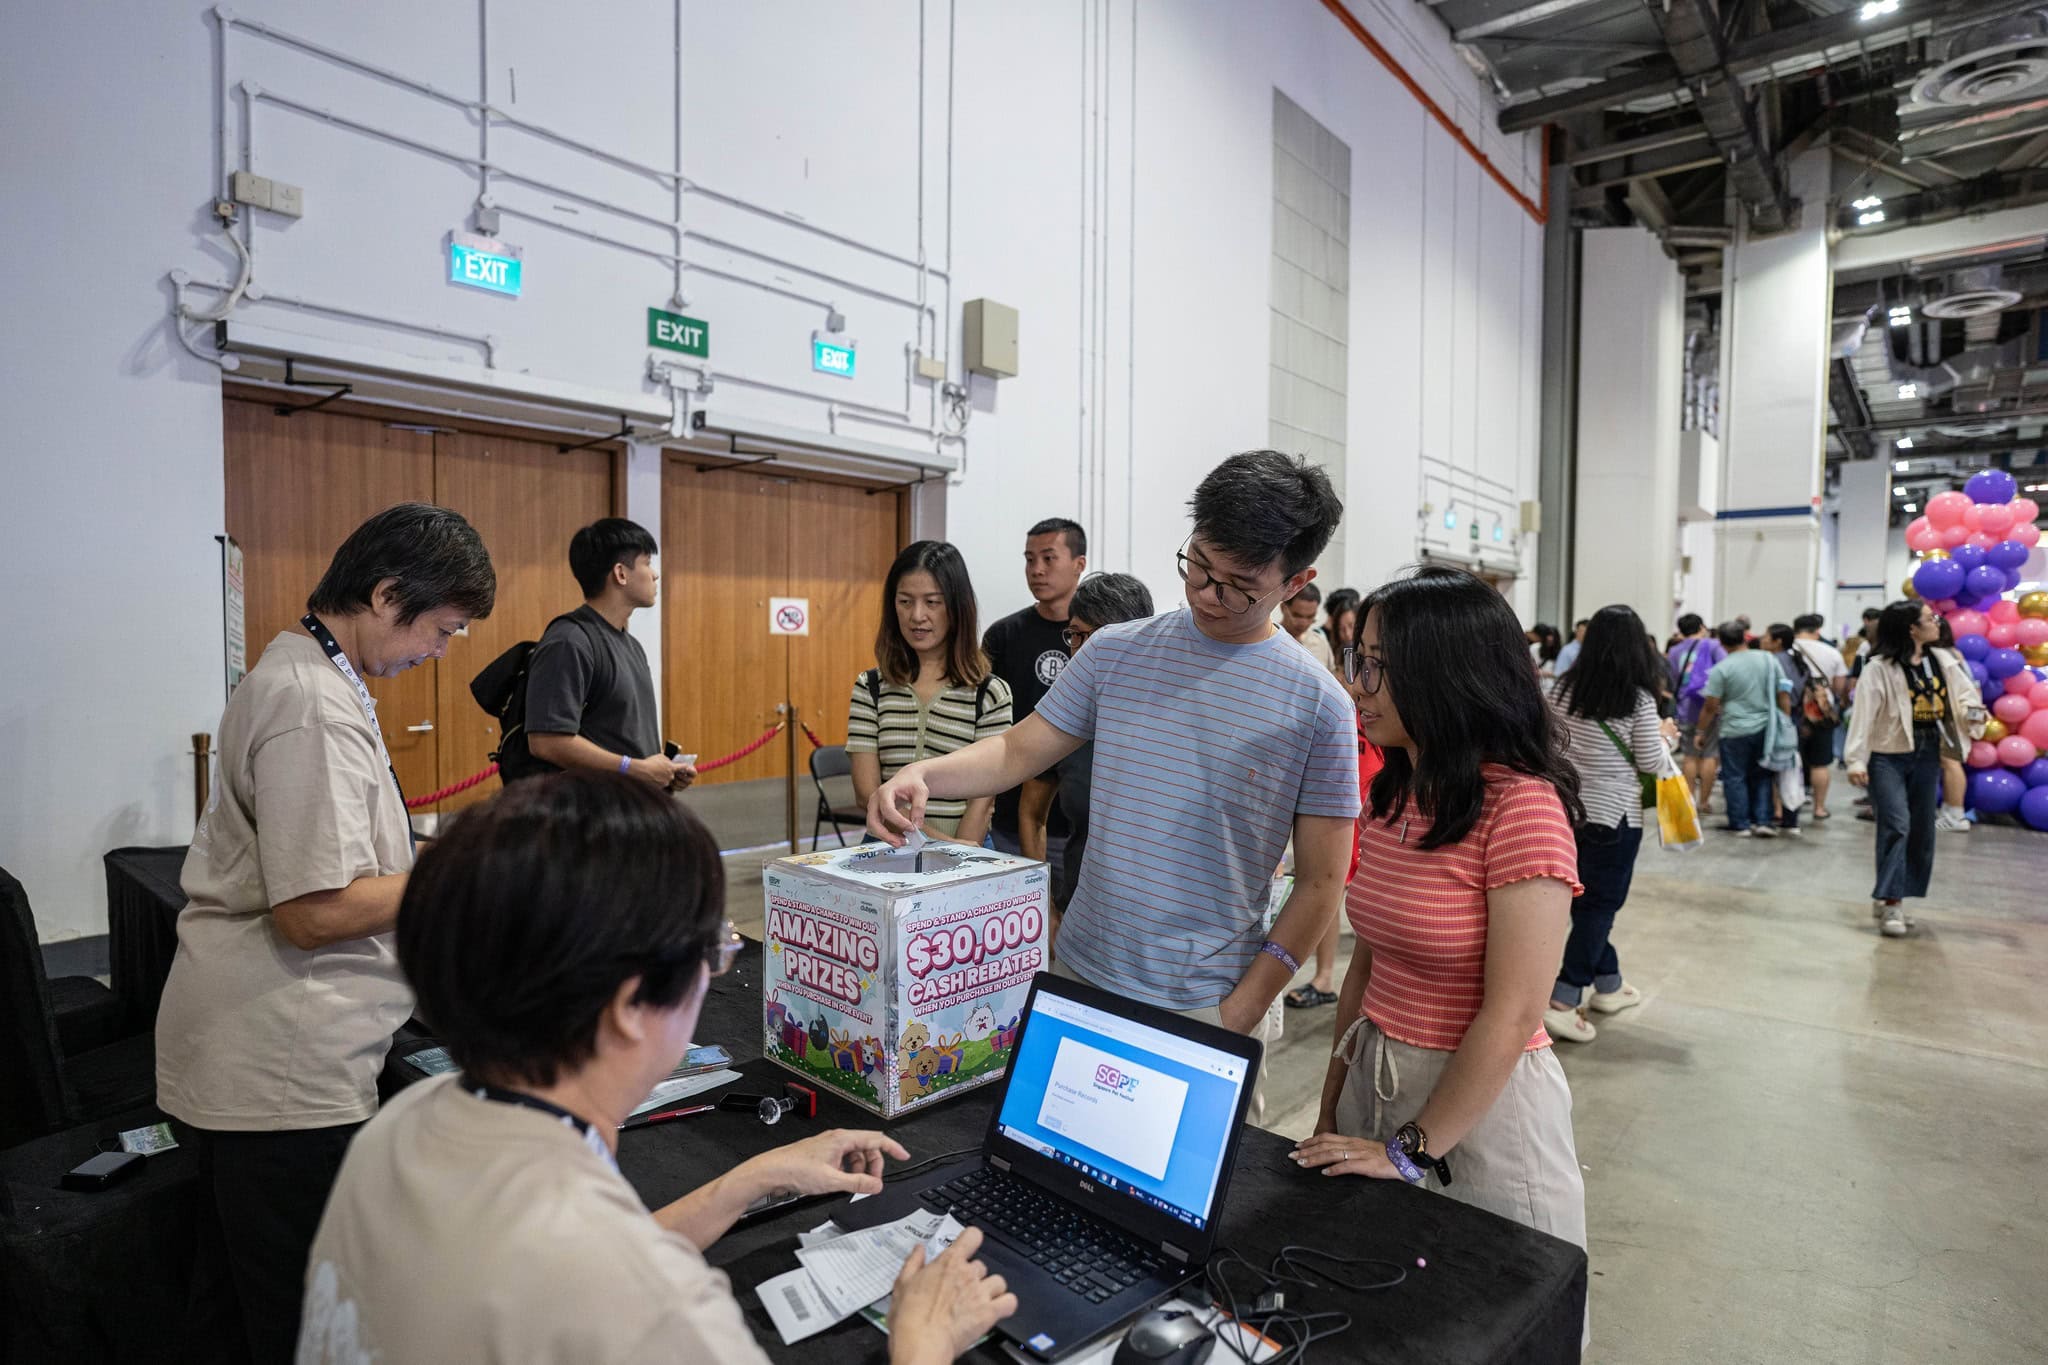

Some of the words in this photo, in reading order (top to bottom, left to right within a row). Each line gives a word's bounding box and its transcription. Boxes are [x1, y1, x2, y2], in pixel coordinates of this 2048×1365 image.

[466, 253, 509, 286] EXIT
[656, 319, 703, 348] EXIT
[821, 347, 849, 371] EXIT
[1049, 659, 1057, 677] B
[770, 894, 788, 908] SPEND
[791, 900, 811, 914] STAND
[810, 904, 817, 915] A
[816, 906, 840, 923] CHANCE
[839, 913, 850, 926] TO
[849, 916, 863, 930] WIN
[862, 920, 877, 935] OUR
[906, 919, 933, 933] SPEND
[933, 916, 941, 927] &
[941, 910, 967, 926] STAND
[967, 908, 974, 919] A
[973, 901, 1003, 917] CHANCE
[1002, 898, 1013, 909] TO
[1012, 894, 1027, 907] WIN
[1026, 890, 1041, 902] OUR
[768, 908, 879, 972] AMAZING
[907, 906, 1042, 979] $30,000
[784, 947, 861, 1005] PRIZES
[908, 969, 966, 1006] CASH
[966, 947, 1041, 989] REBATES
[914, 1001, 939, 1017] WHEN
[939, 997, 957, 1010] YOU
[956, 983, 994, 1004] PURCHASE
[993, 981, 1002, 993] IN
[1002, 978, 1016, 990] OUR
[1016, 970, 1035, 985] EVENT
[776, 978, 792, 992] WHEN
[791, 983, 803, 997] YOU
[802, 988, 832, 1008] PURCHASE
[831, 999, 840, 1011] IN
[839, 1002, 852, 1017] OUR
[851, 1008, 873, 1024] EVENT
[1054, 1081, 1077, 1095] Purchase
[1079, 1180, 1095, 1193] DELL
